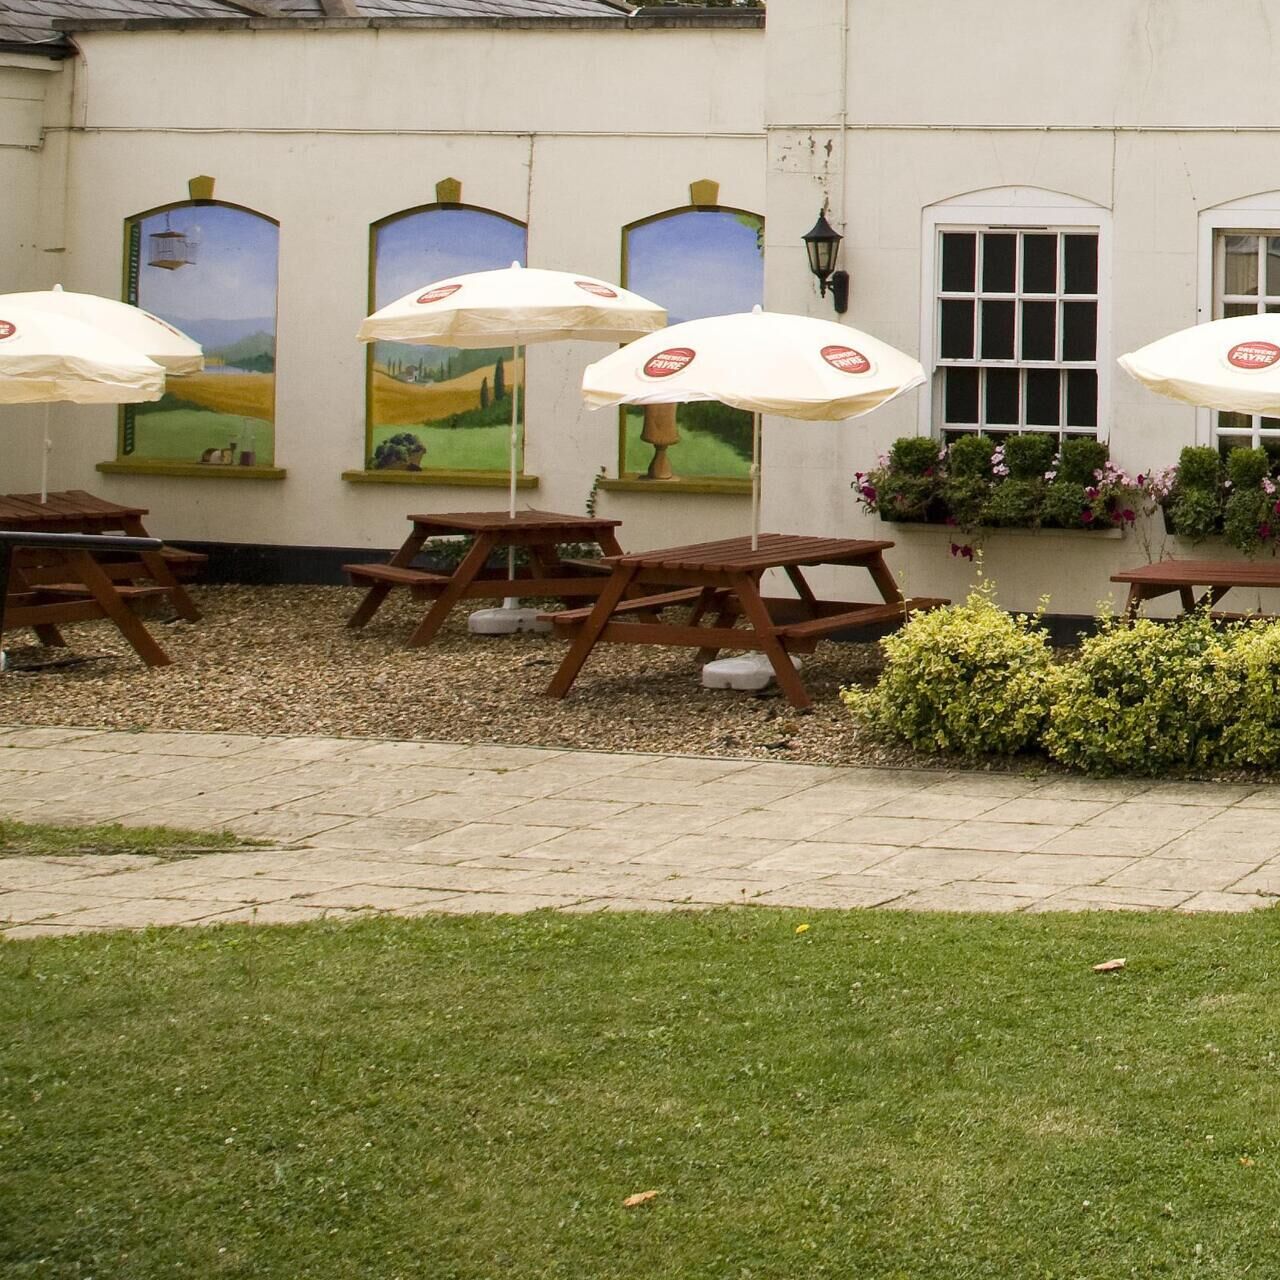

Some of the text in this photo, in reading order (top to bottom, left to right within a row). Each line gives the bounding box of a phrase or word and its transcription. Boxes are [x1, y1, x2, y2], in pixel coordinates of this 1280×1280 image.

[1237, 346, 1277, 356] BREWERS
[656, 353, 692, 362] BREWERS
[831, 357, 866, 368] FAYRE
[1231, 352, 1275, 363] FAYRE
[649, 359, 685, 371] FAYRE
